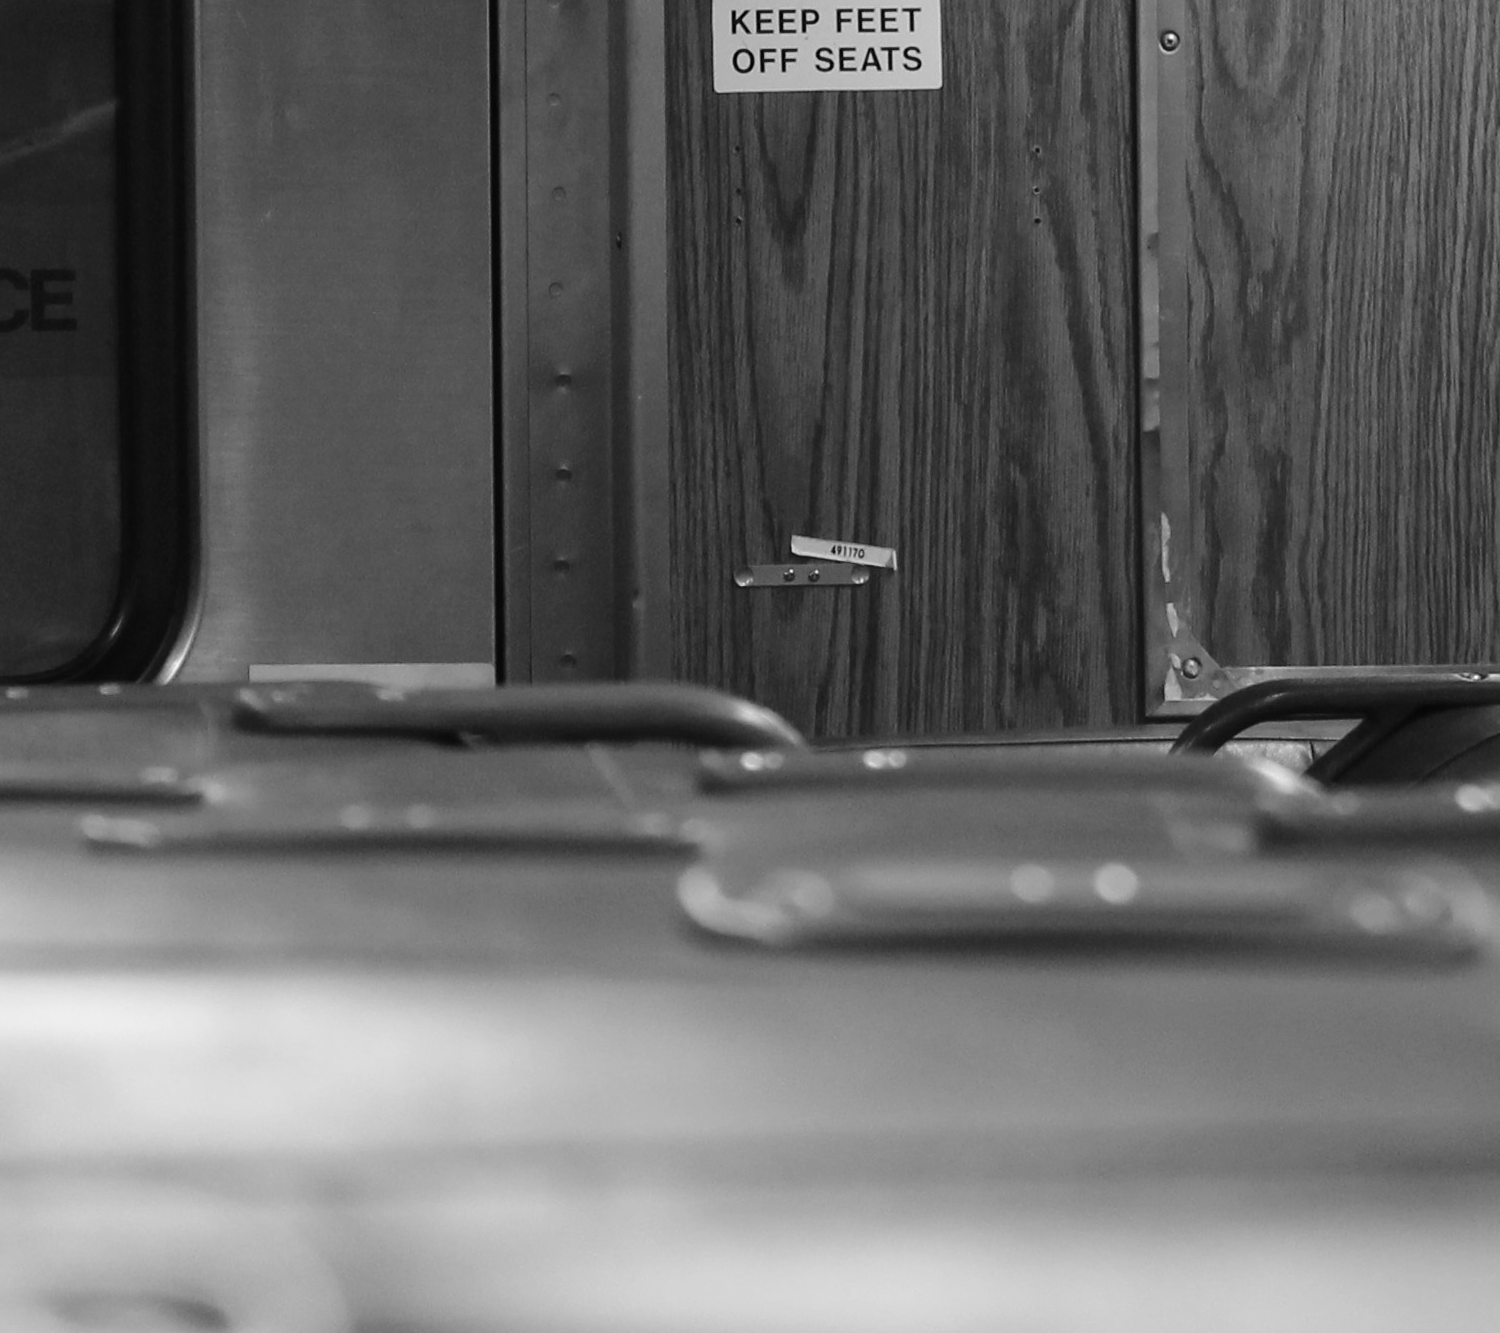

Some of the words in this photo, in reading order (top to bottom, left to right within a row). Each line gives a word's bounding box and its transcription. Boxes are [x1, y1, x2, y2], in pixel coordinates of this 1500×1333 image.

[731, 8, 820, 35] KEEP
[836, 7, 921, 33] FEET
[732, 48, 798, 74] OFF
[815, 45, 923, 73] SEATS
[830, 544, 866, 560] 491170
